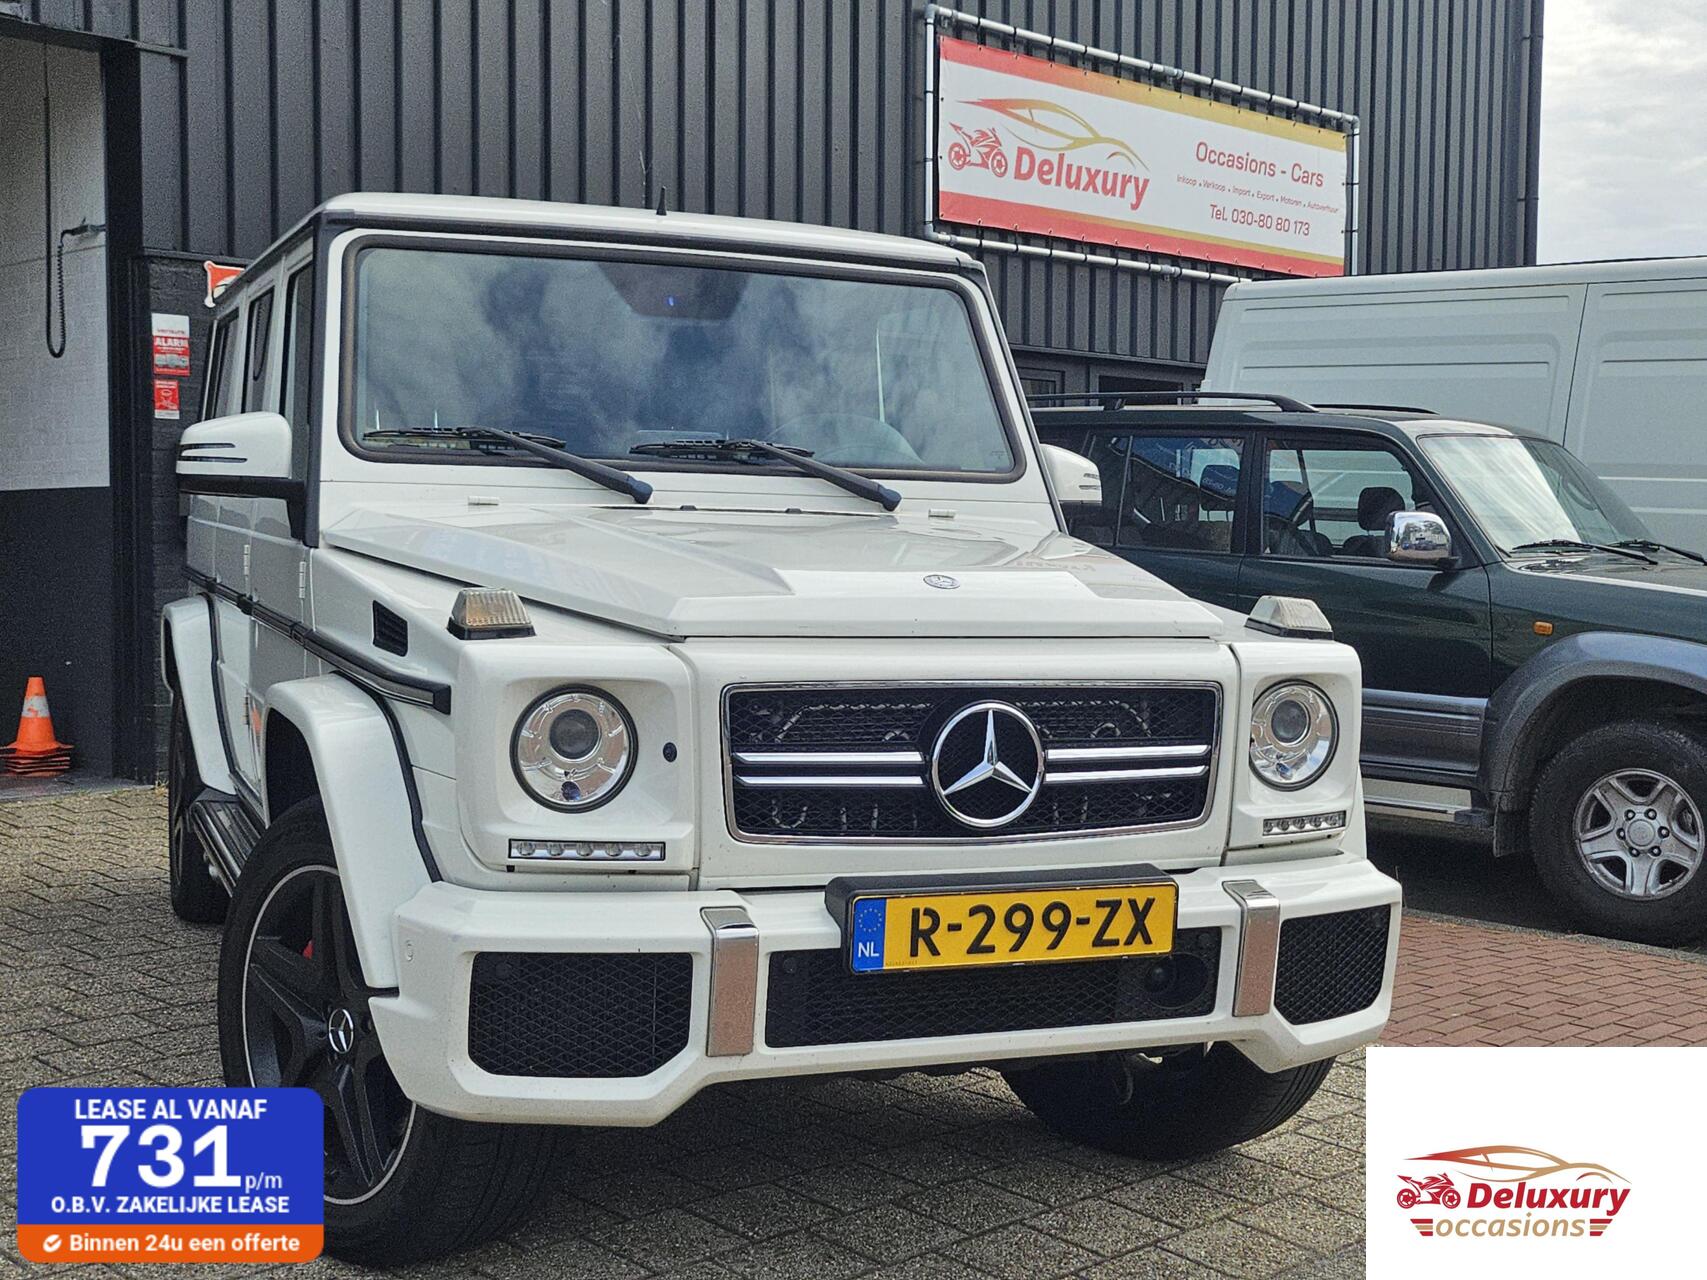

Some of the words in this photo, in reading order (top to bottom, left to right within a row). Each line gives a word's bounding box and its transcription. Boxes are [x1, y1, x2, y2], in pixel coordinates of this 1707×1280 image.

[1014, 146, 1149, 210] Deluxury
[1196, 141, 1276, 177] Occasions
[1291, 163, 1324, 187] Cars
[1232, 185, 1251, 197] Import
[1256, 191, 1275, 202] Export
[1210, 204, 1228, 222] Tel.
[1231, 208, 1273, 230] 030-80
[1276, 217, 1291, 233] 80
[1294, 220, 1310, 236] 173
[154, 337, 189, 349] ALARM
[909, 896, 1156, 958] R-299-ZX
[858, 941, 880, 958] NL
